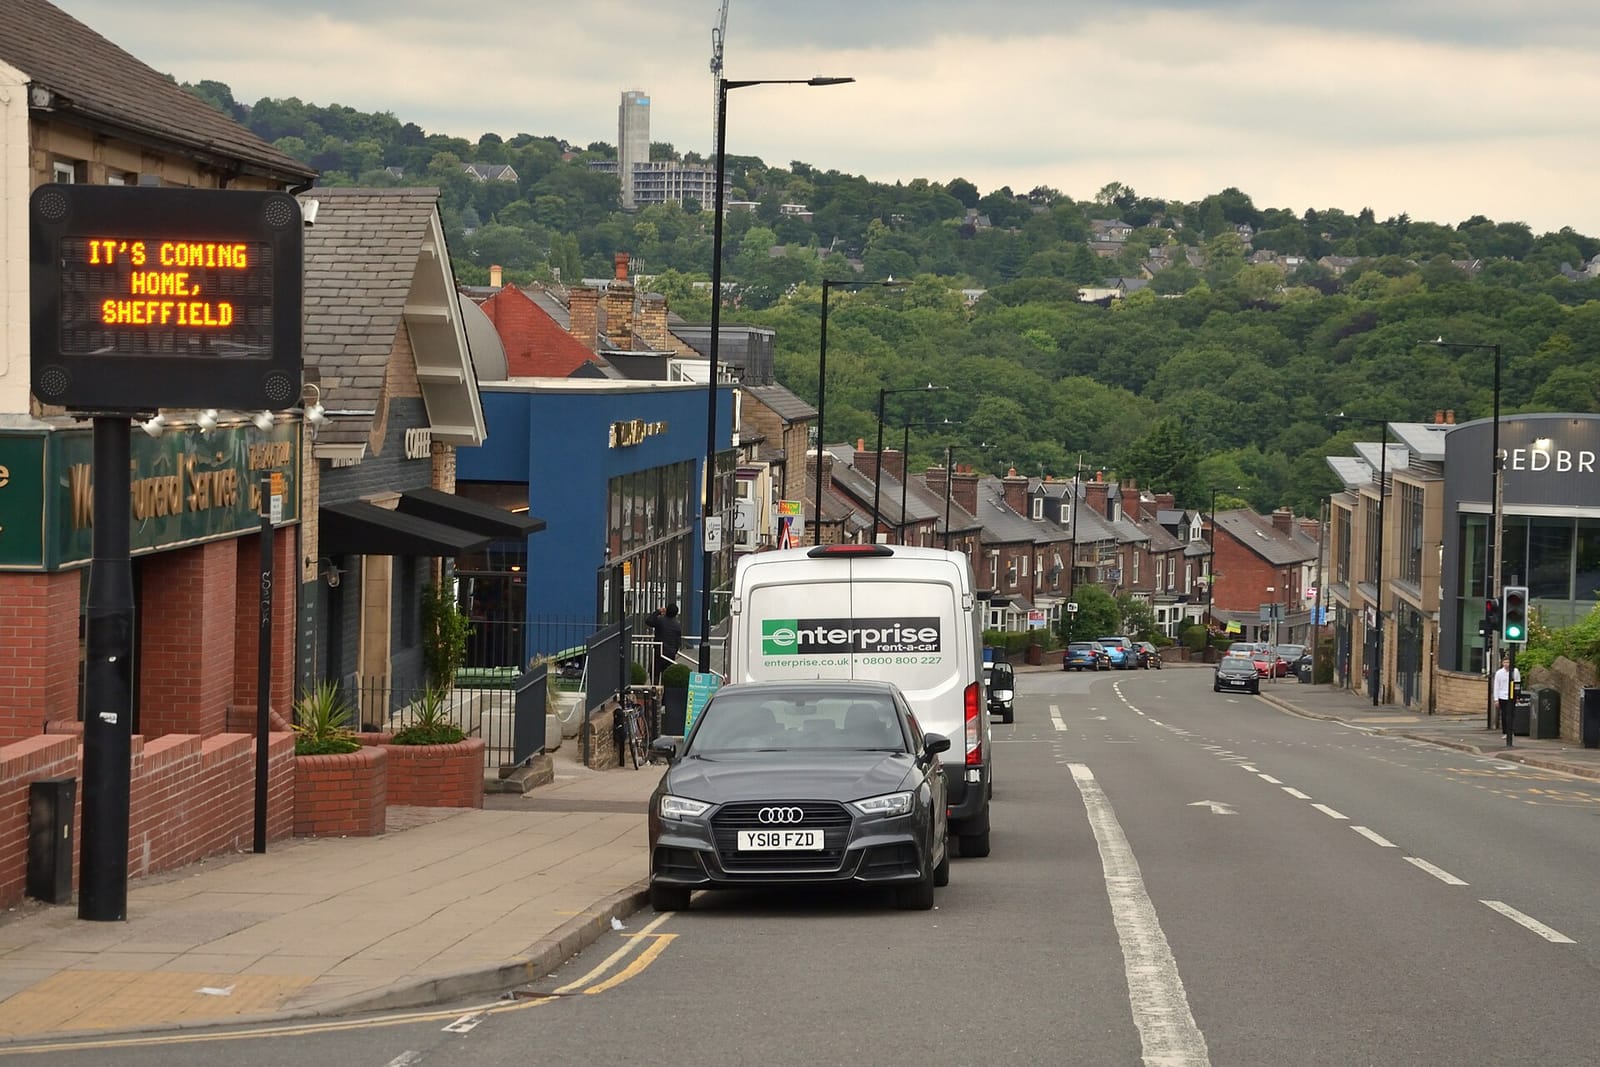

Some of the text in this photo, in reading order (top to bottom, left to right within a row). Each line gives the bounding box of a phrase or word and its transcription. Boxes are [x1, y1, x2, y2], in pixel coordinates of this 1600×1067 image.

[89, 240, 247, 268] IT'S COMING
[131, 271, 201, 296] HOME,
[102, 300, 233, 326] SHEFFIELD
[405, 428, 432, 460] COFFEE
[184, 452, 238, 513] Service
[767, 623, 938, 649] enterprise
[877, 643, 938, 652] rent-a-car
[764, 656, 942, 668] enterprise.co.uk 0800 800 227
[747, 832, 814, 847] YS18 FZD
